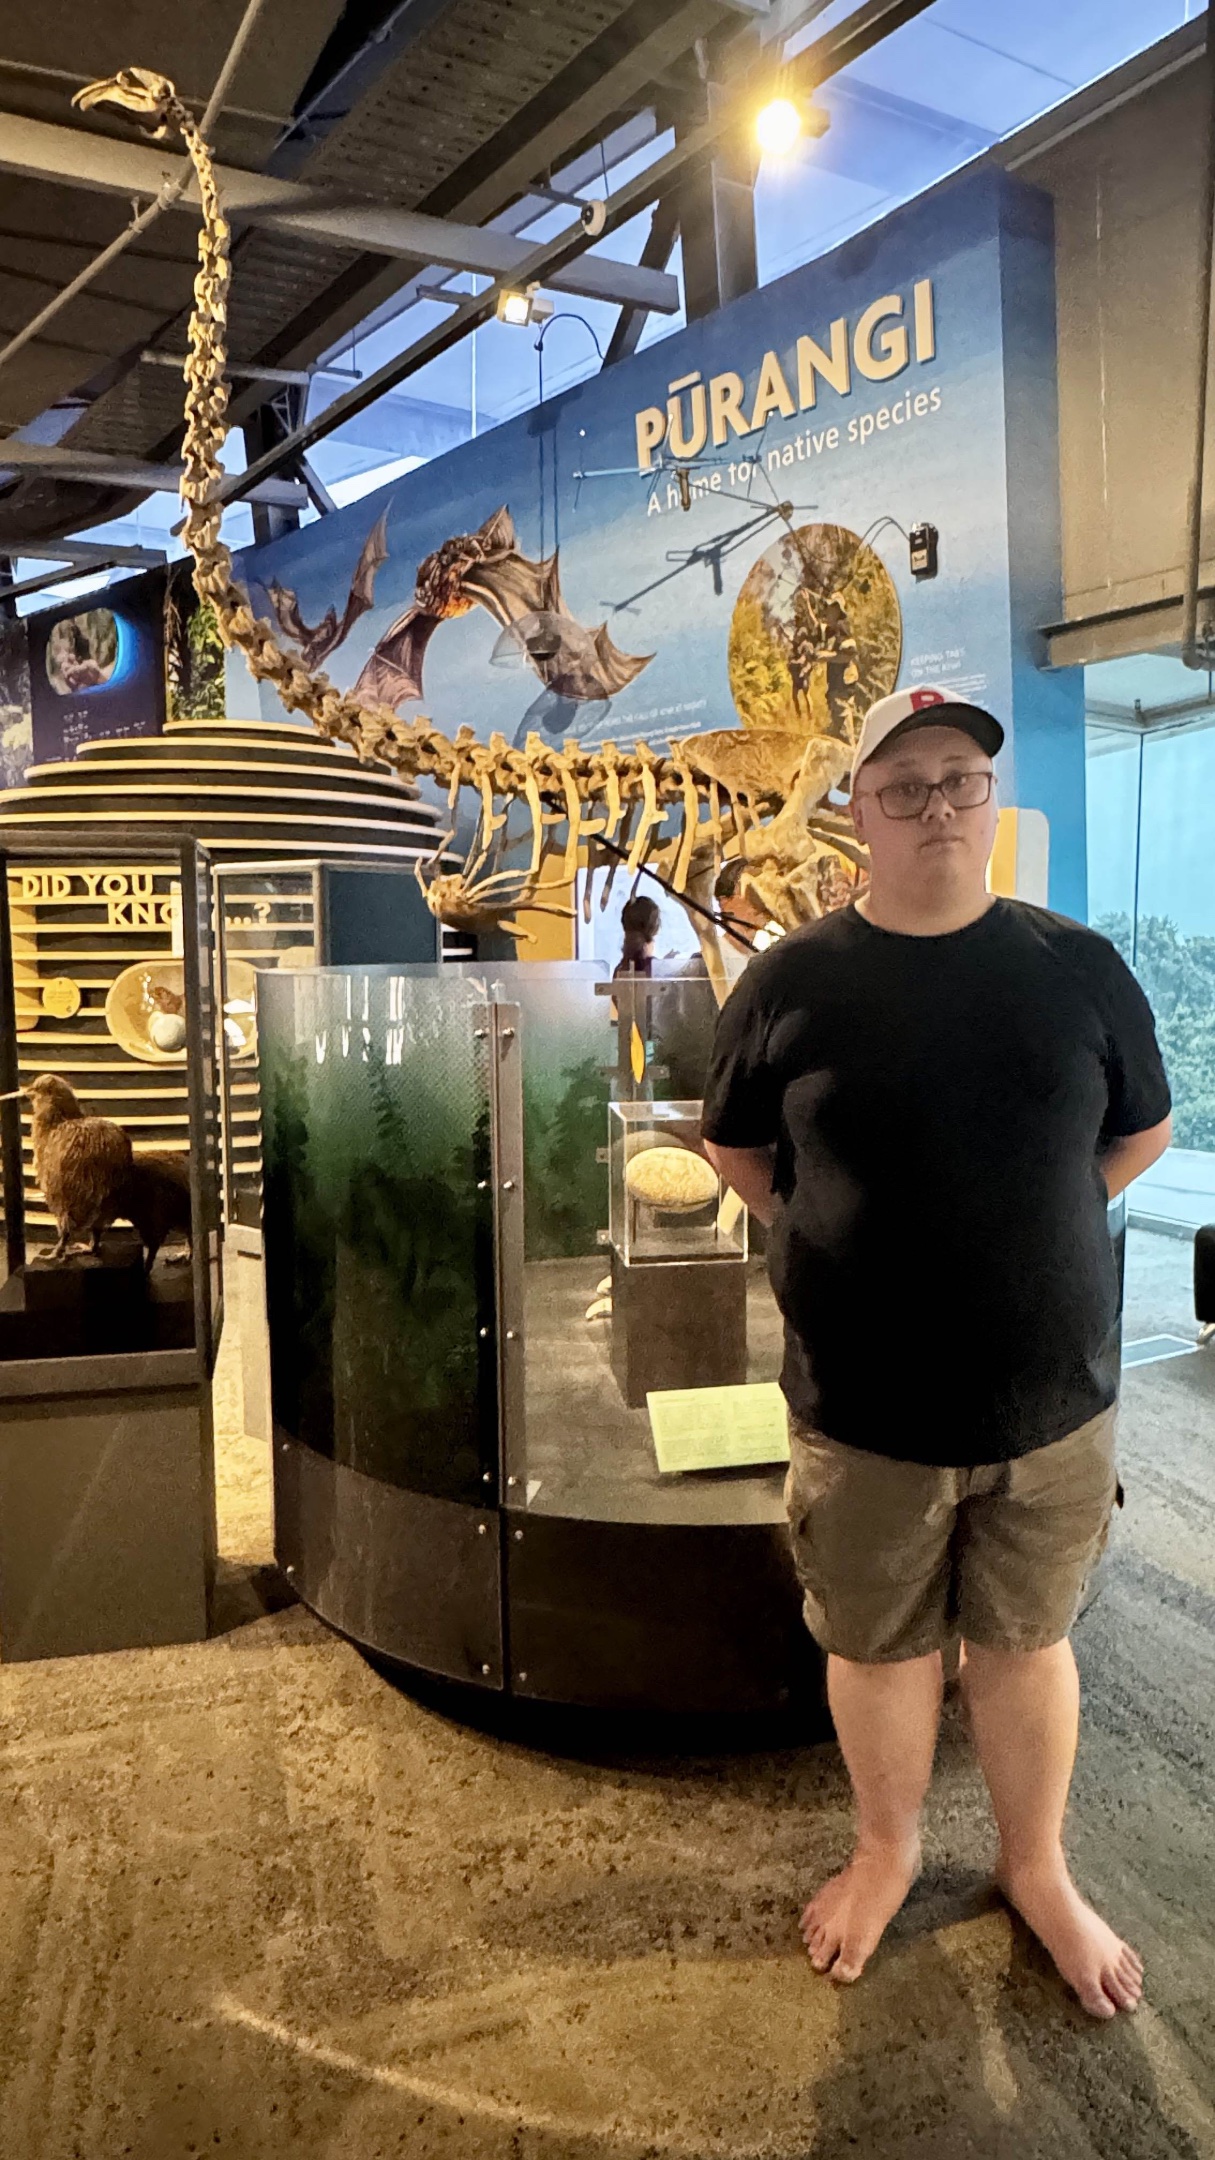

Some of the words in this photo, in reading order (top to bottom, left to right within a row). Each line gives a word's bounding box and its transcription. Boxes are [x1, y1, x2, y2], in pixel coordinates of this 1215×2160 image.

[635, 279, 935, 477] PŪRANGI
[647, 491, 661, 517] A
[667, 471, 722, 510] hme
[766, 428, 839, 472] native
[848, 387, 942, 445] species
[22, 874, 71, 898] DID
[81, 873, 154, 897] YOU
[107, 902, 173, 926] KNO
